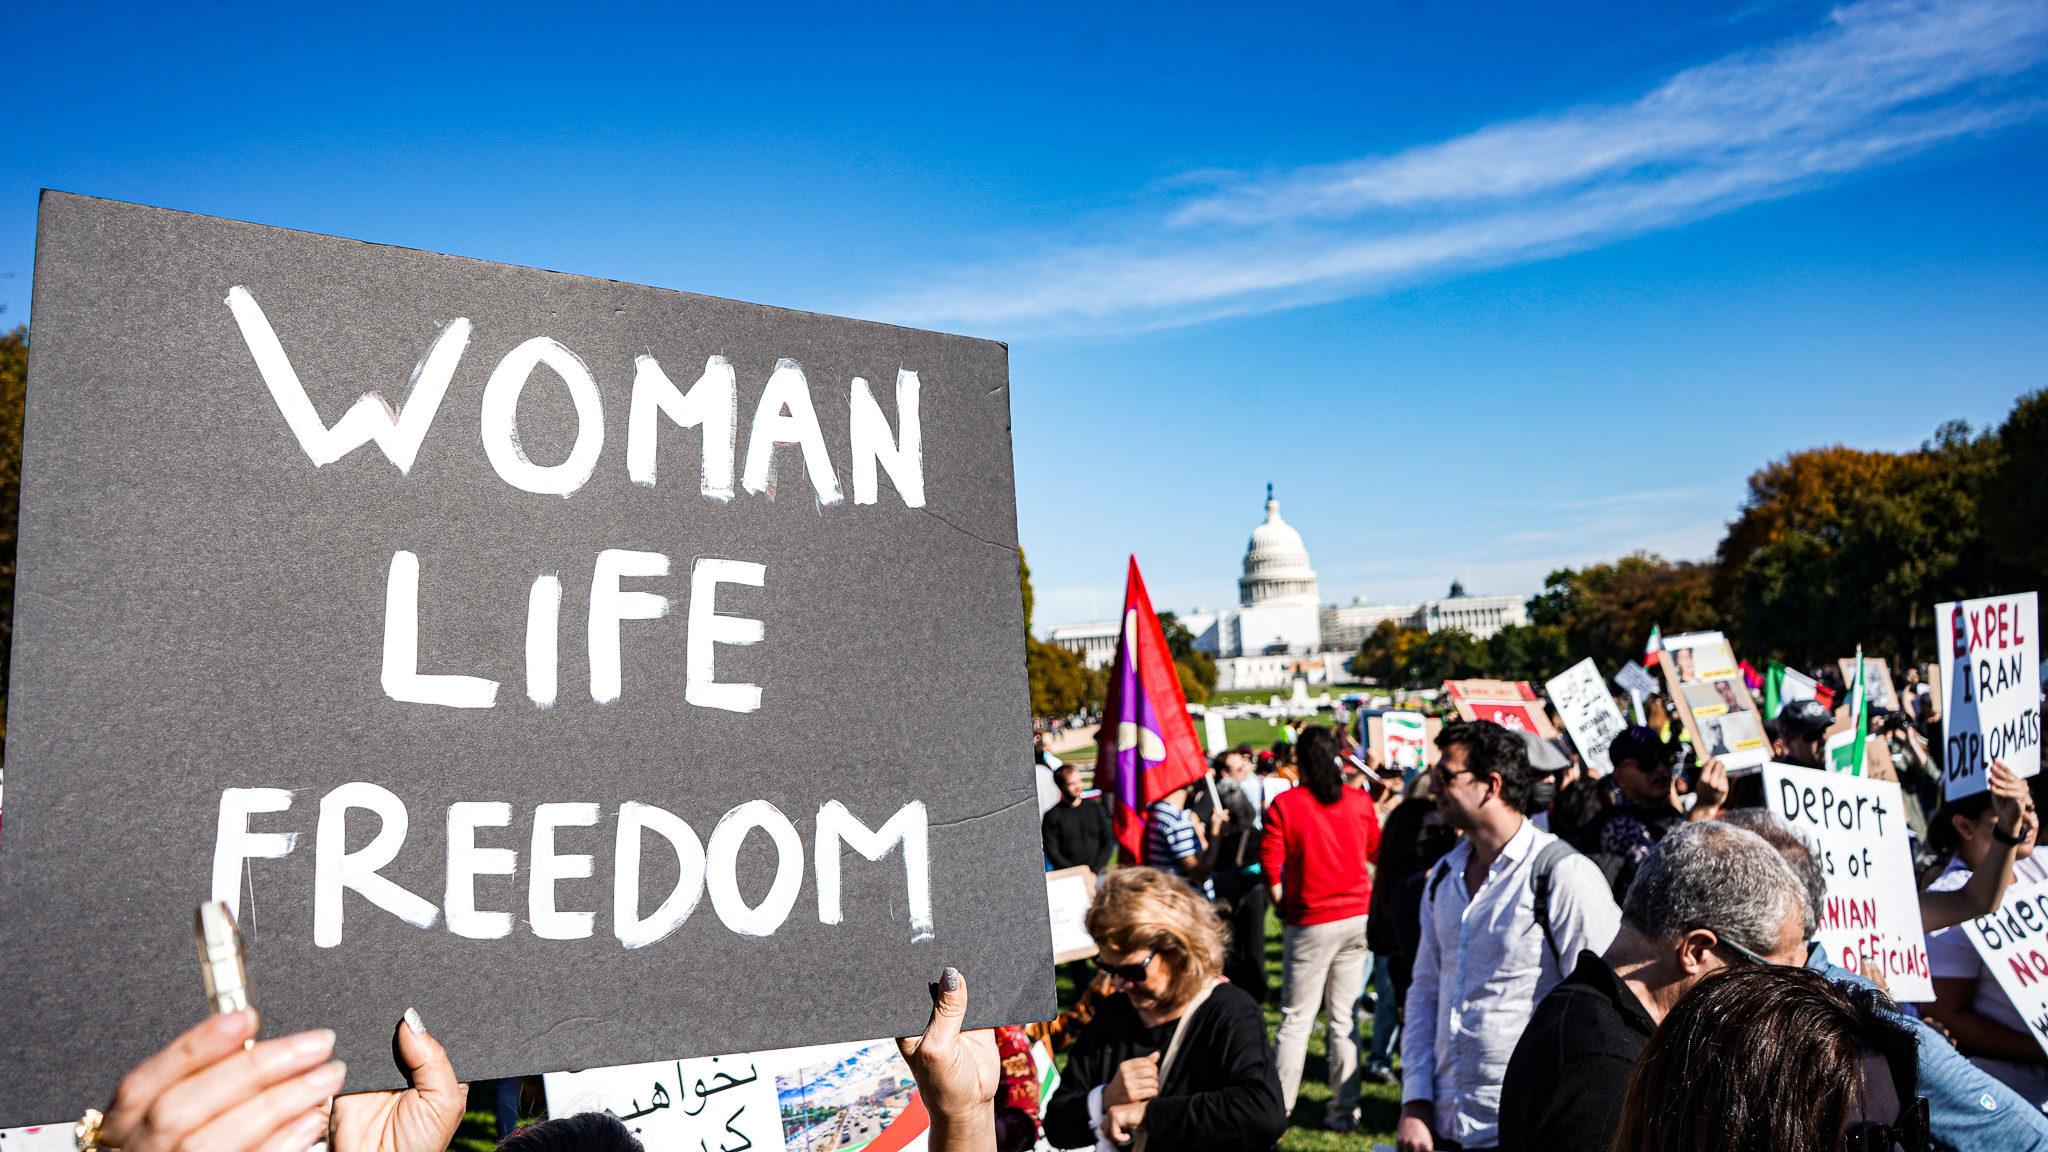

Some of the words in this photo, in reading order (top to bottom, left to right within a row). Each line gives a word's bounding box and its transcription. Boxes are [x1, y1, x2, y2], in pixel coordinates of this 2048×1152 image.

[224, 285, 927, 510] WOMAN
[381, 549, 768, 714] LIFE
[1952, 603, 2024, 659] EXPEL
[1963, 652, 2022, 704] IRAN
[1948, 708, 2041, 782] DIPLOMATS
[211, 781, 936, 950] FREEDOM
